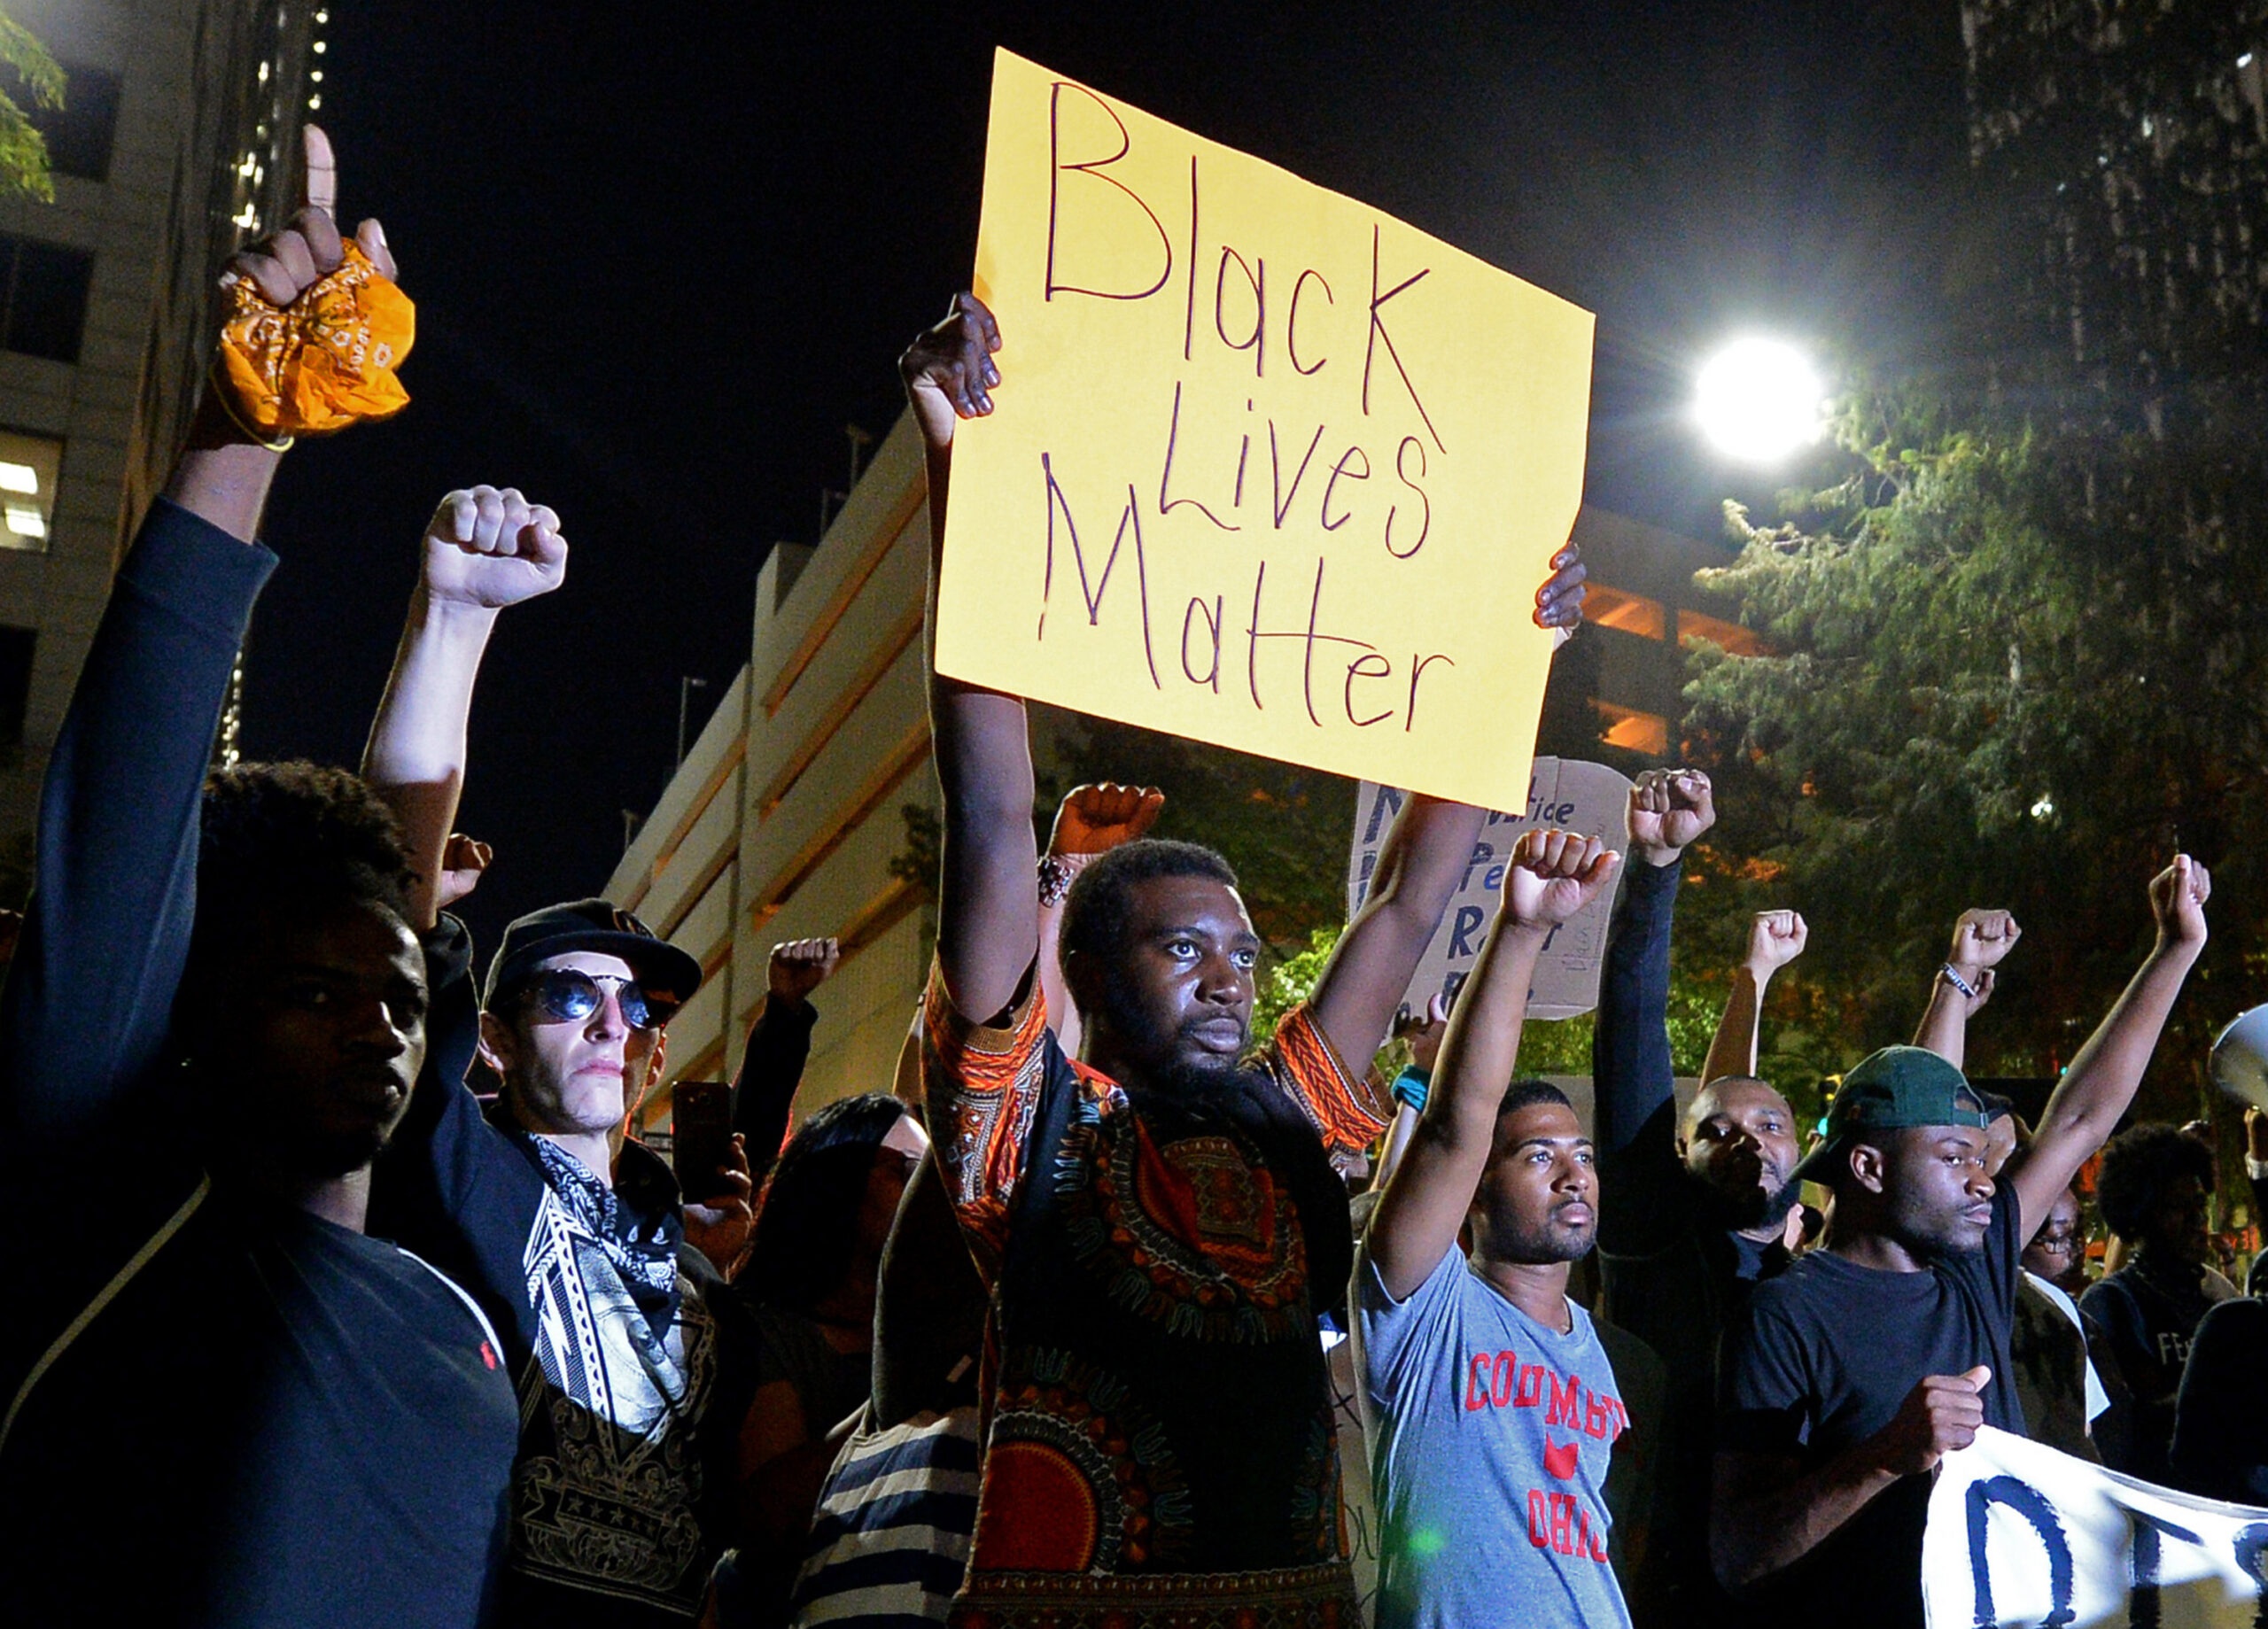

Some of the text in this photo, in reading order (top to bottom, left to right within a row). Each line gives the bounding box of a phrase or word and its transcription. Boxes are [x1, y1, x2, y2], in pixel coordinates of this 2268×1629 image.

[1047, 81, 1446, 454] Black
[1038, 452, 1456, 732] Matter
[1160, 381, 1430, 559] Lives
